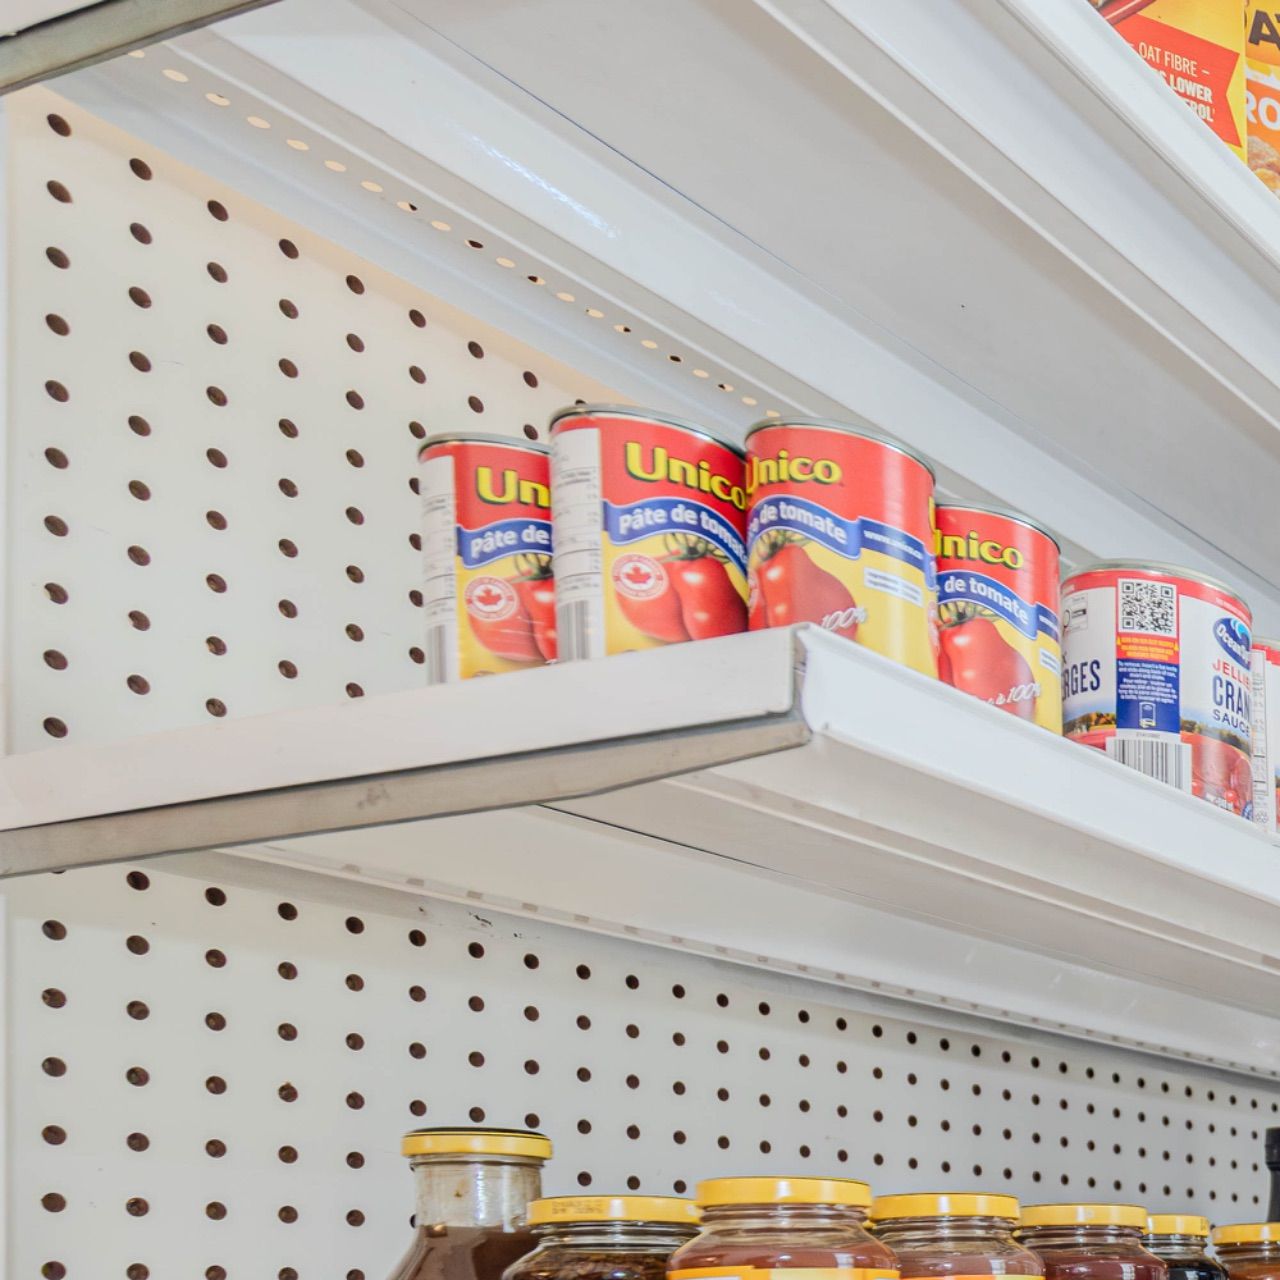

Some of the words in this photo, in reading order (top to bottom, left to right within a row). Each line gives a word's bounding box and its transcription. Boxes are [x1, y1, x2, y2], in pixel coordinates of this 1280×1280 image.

[1138, 42, 1161, 64] OAT
[1164, 50, 1198, 77] FIBRE
[1169, 74, 1213, 104] LOWER
[626, 441, 747, 511] Unico
[619, 508, 668, 536] Pâte
[671, 502, 698, 525] de
[760, 503, 778, 522] de
[780, 501, 847, 545] tomate
[470, 530, 518, 560] Pâte
[522, 524, 550, 545] de
[944, 577, 965, 592] de
[969, 577, 1028, 624] tomate
